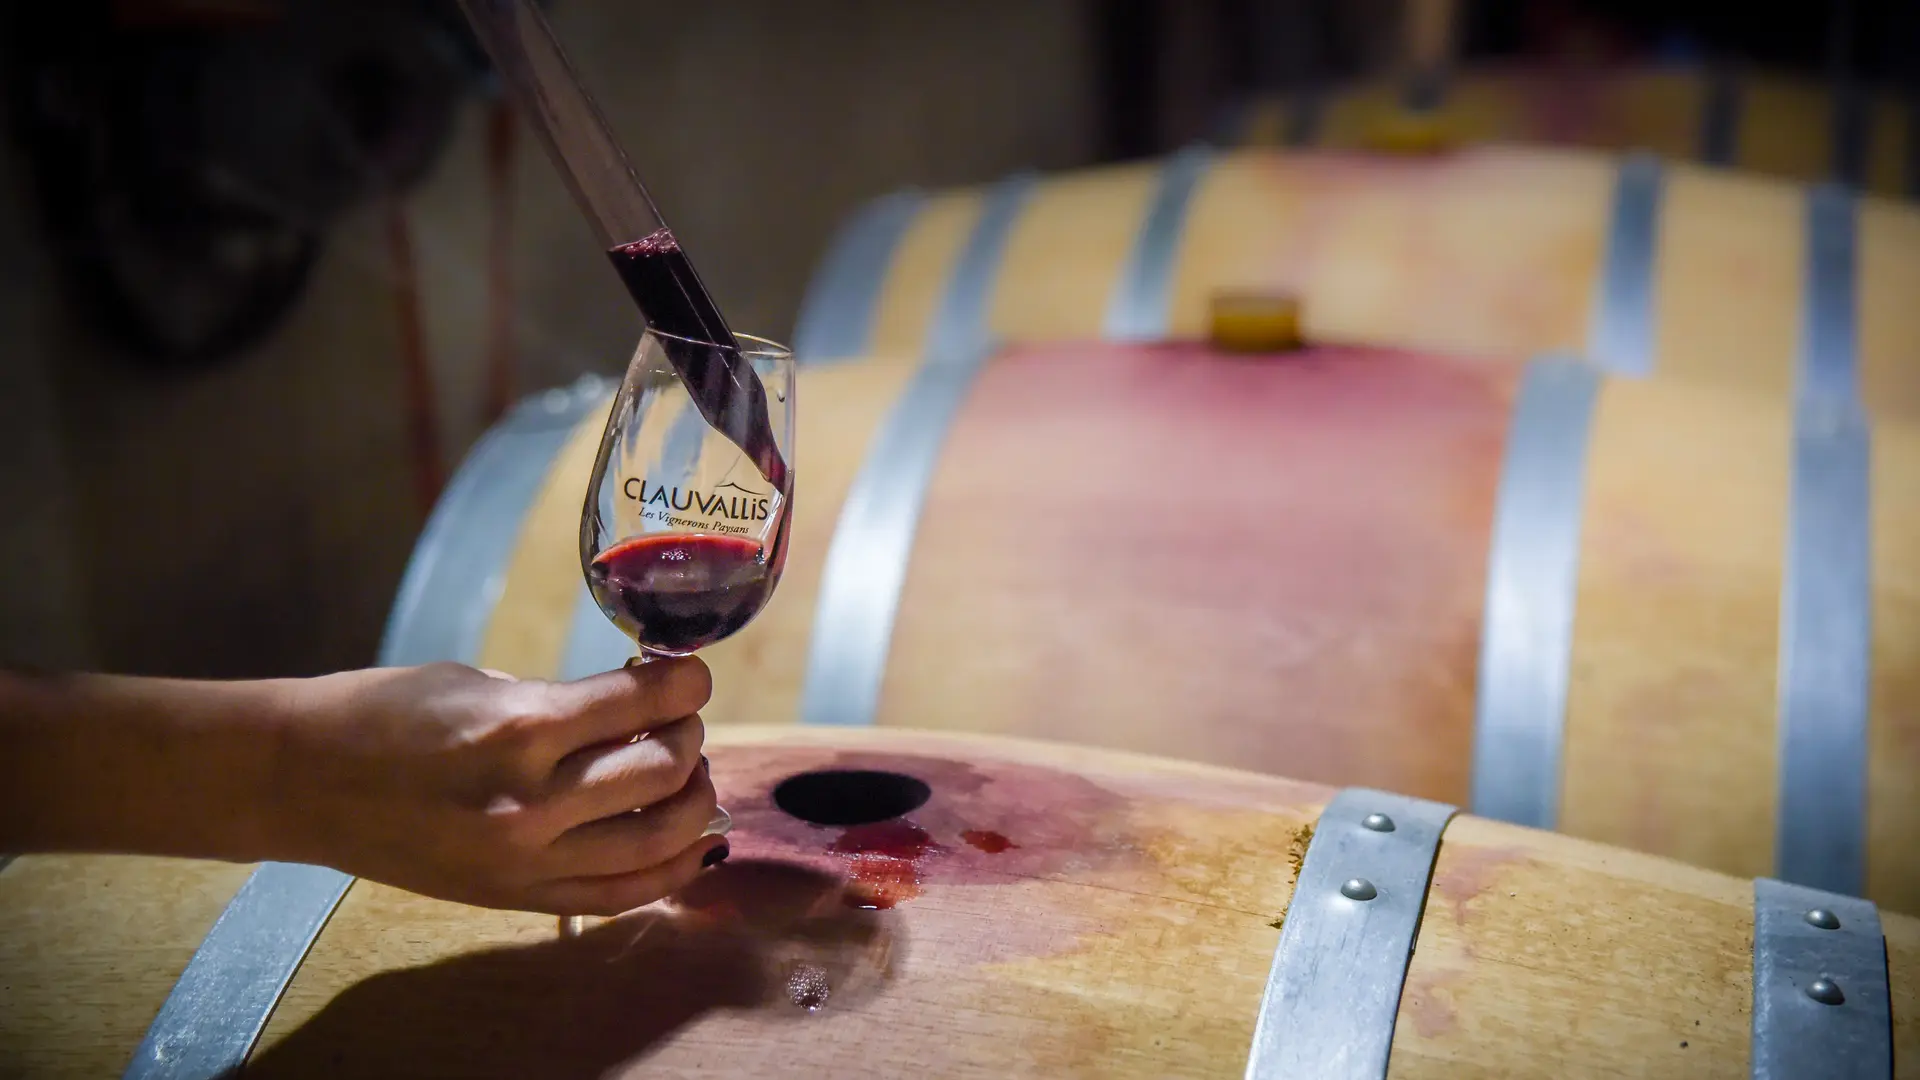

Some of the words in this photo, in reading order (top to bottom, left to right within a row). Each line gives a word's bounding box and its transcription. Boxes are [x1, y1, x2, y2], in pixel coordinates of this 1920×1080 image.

[638, 507, 654, 519] Les
[658, 511, 709, 530] Vignerons
[712, 521, 749, 535] Paysans
